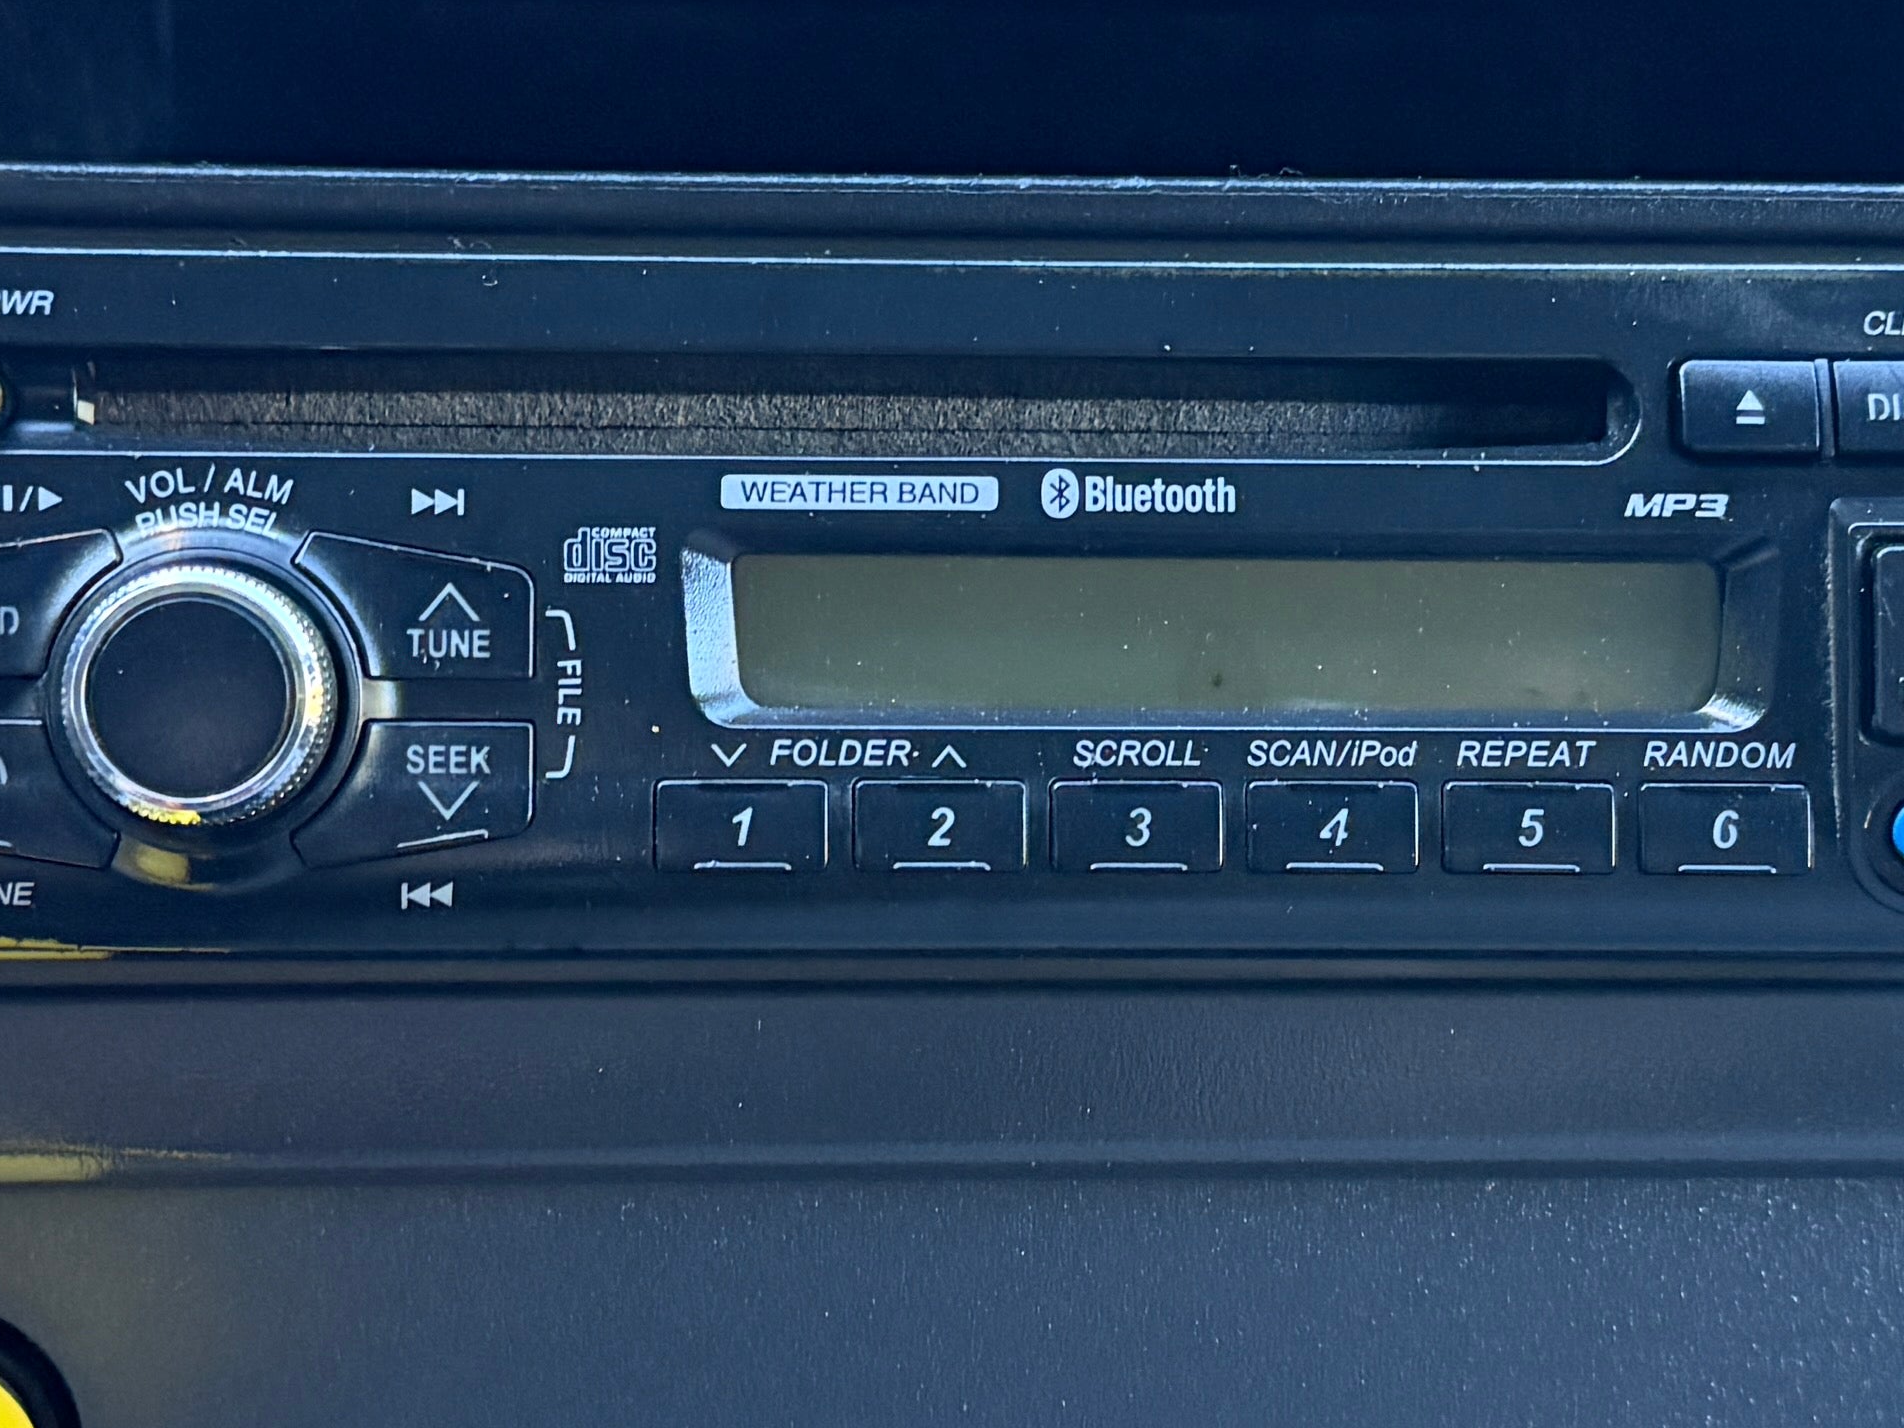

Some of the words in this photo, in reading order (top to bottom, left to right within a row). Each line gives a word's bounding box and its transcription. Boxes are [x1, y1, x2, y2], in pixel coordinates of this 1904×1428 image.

[739, 479, 890, 505] WEATHER
[896, 480, 981, 507] BAND
[1083, 475, 1237, 515] Bluetooth
[1623, 492, 1730, 519] MP3
[133, 500, 221, 538] PUSH
[225, 503, 283, 539] SEL
[591, 526, 657, 539] COMPACT
[563, 572, 613, 584] DIGITAL
[615, 572, 657, 584] AUDIO
[406, 628, 492, 660] TUNE
[555, 658, 583, 726] FILE
[404, 744, 492, 775] SEEK
[768, 738, 910, 768] FOLDER
[1071, 738, 1202, 768] SCROLL
[1246, 739, 1418, 769] SCAN/iPod
[1456, 739, 1598, 769] REPEAT
[1642, 740, 1797, 770] RANDOM
[730, 806, 755, 848] 1
[926, 806, 957, 848] 2
[1123, 806, 1152, 848] 3
[1317, 807, 1351, 848] 4
[1516, 807, 1545, 849] 5
[1711, 808, 1740, 850] 6
